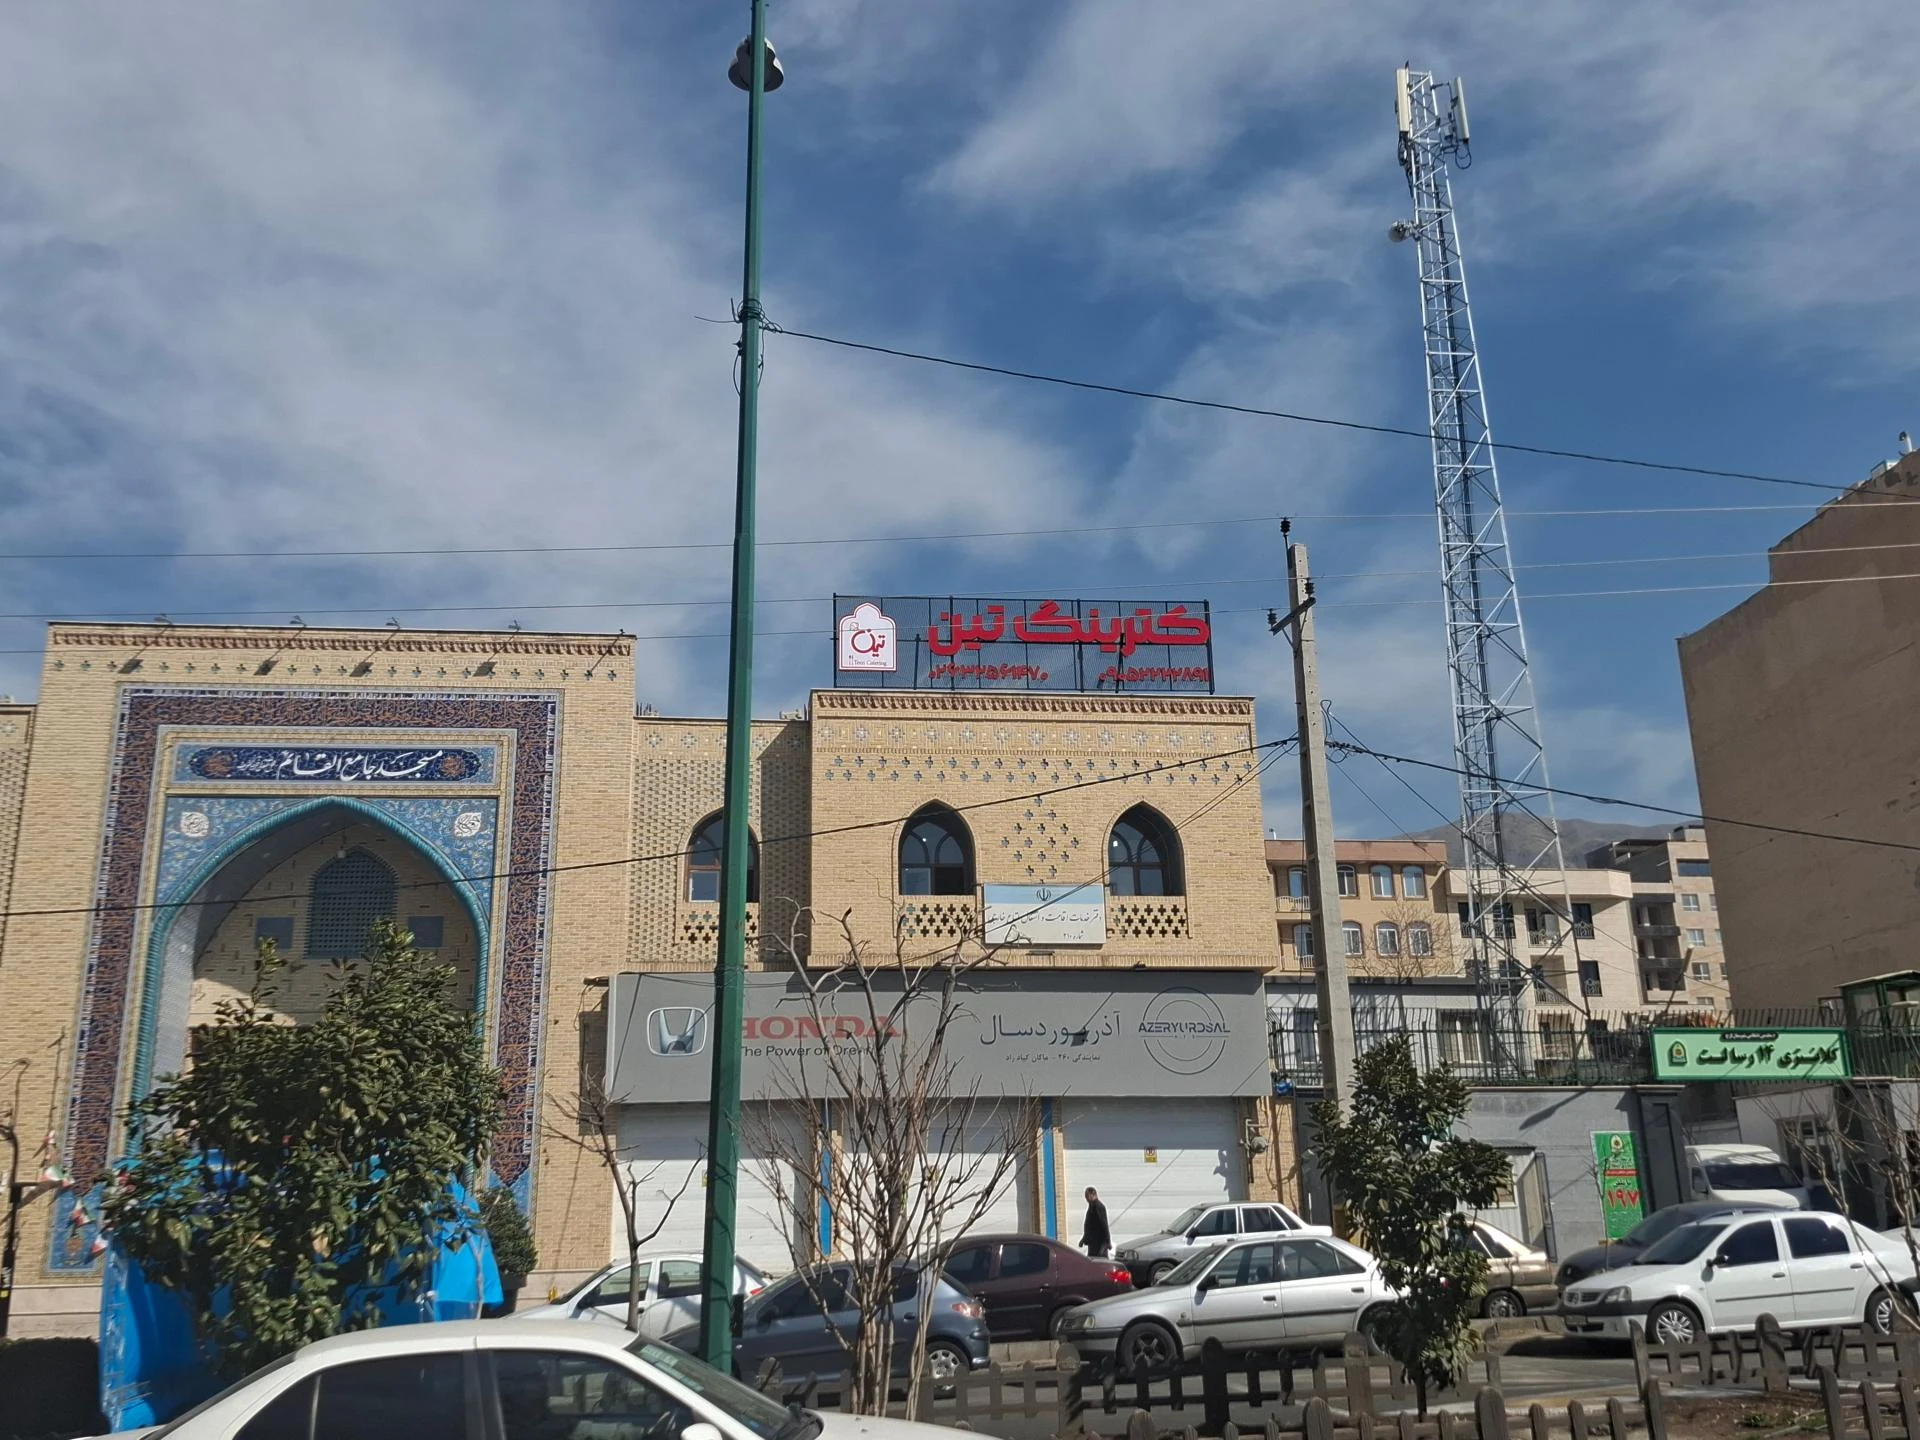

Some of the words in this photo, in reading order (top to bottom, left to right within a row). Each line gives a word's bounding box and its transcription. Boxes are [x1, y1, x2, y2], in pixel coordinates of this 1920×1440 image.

[928, 605, 1005, 656] تین
[1013, 600, 1210, 657] کترینگ
[851, 629, 886, 657] تین
[375, 749, 443, 778] مسجد
[766, 1045, 810, 1057] Power
[1608, 1188, 1640, 1209] ۱۹۷
